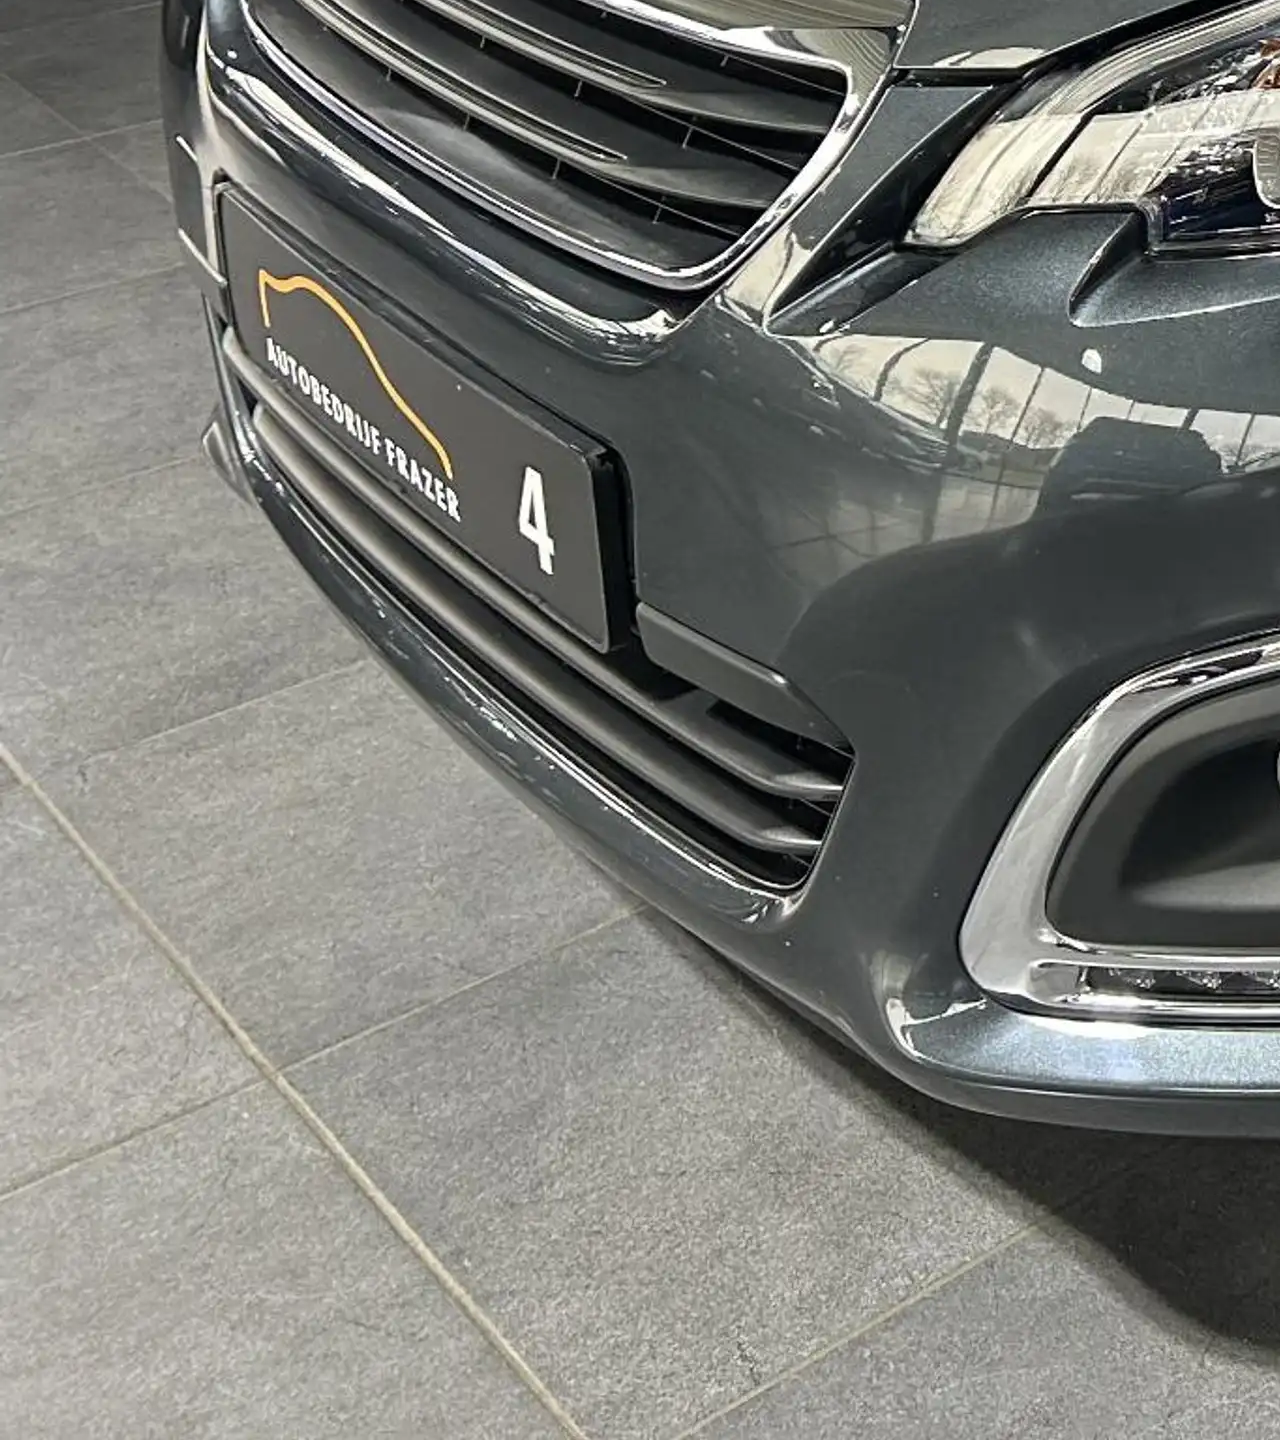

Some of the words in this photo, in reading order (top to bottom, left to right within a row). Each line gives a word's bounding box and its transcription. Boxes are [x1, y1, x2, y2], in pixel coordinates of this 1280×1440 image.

[265, 336, 383, 455] AUTOBEDRIJF
[384, 437, 462, 522] FRAZER
[518, 465, 555, 576] 4
